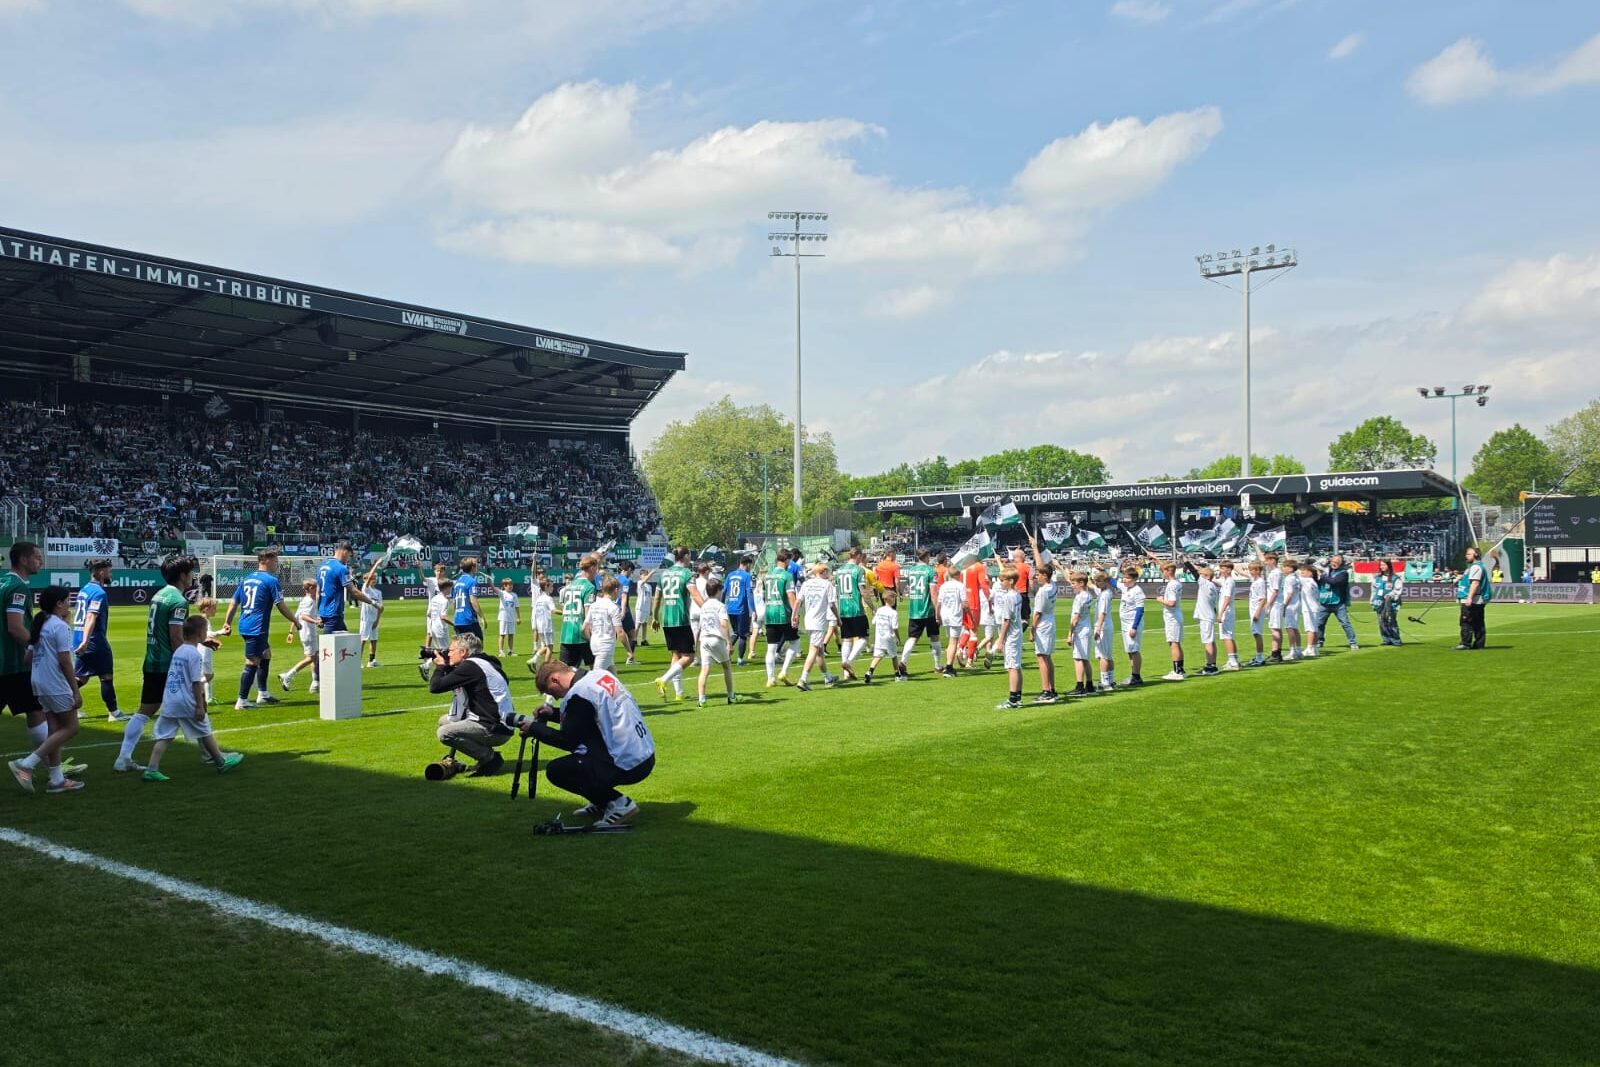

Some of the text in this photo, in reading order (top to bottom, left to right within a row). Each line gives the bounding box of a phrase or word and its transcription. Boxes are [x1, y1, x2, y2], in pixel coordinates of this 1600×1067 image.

[402, 311, 424, 327] LVM
[1320, 476, 1379, 490] guidecom
[973, 483, 1234, 504] Gemesam digitale Erfolgsgeschichten schreiben.
[877, 499, 914, 509] guidecom
[47, 543, 94, 553] METTeagle
[662, 577, 680, 598] 22
[729, 580, 740, 597] 18
[766, 579, 779, 599] 14
[839, 574, 852, 593] 10
[909, 576, 925, 593] 24
[242, 586, 258, 609] 31
[562, 590, 582, 615] 25
[74, 600, 86, 625] 23
